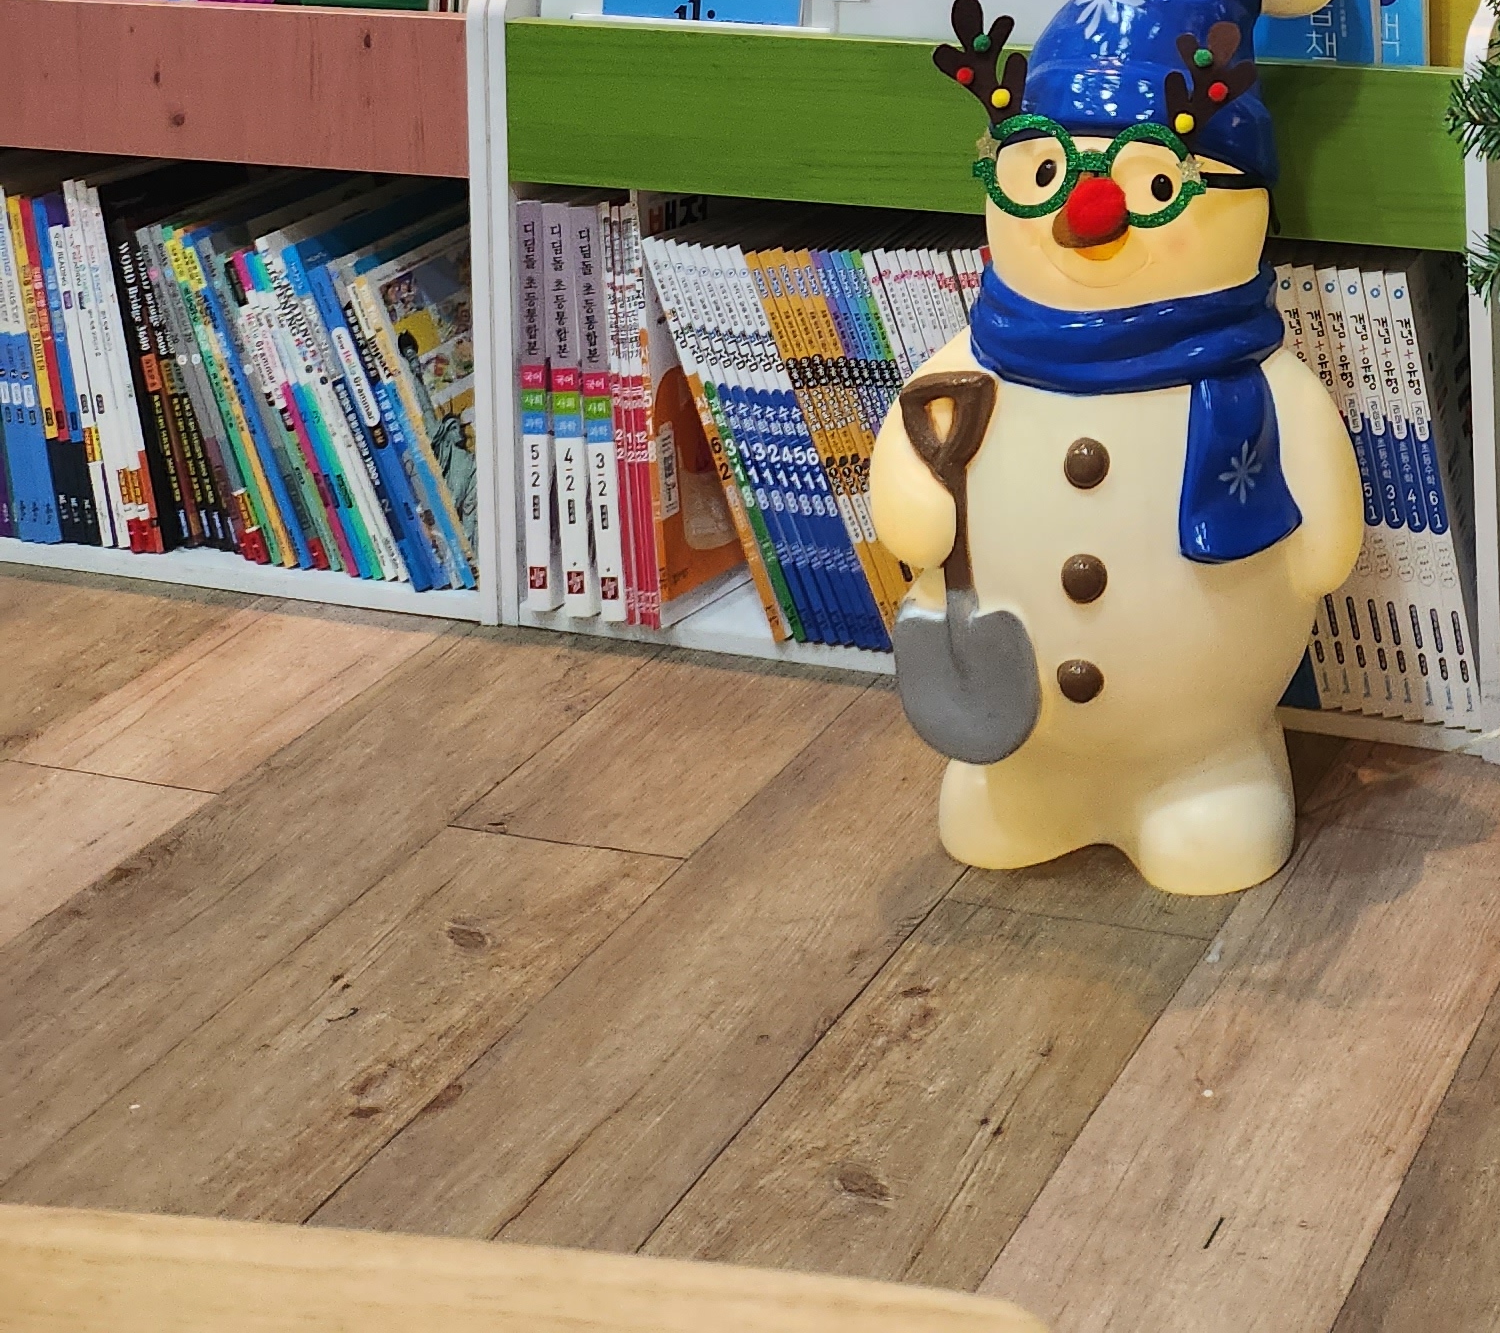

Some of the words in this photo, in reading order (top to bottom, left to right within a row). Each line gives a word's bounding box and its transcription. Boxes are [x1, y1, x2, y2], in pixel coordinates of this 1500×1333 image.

[523, 221, 536, 270] 디딤돌
[551, 224, 565, 271] 디딤돌
[579, 228, 594, 276] 디딤돌
[116, 241, 138, 284] WORD
[124, 285, 146, 323] Bridge
[261, 260, 303, 338] LISTENING
[333, 332, 347, 351] New
[339, 349, 359, 377] Hello
[523, 369, 543, 383] 국어
[554, 373, 574, 387] 국어
[586, 377, 605, 390] 국어
[349, 374, 379, 423] Grammar
[524, 394, 543, 406] 사회
[556, 398, 575, 409] 사회
[588, 402, 606, 413] 사회
